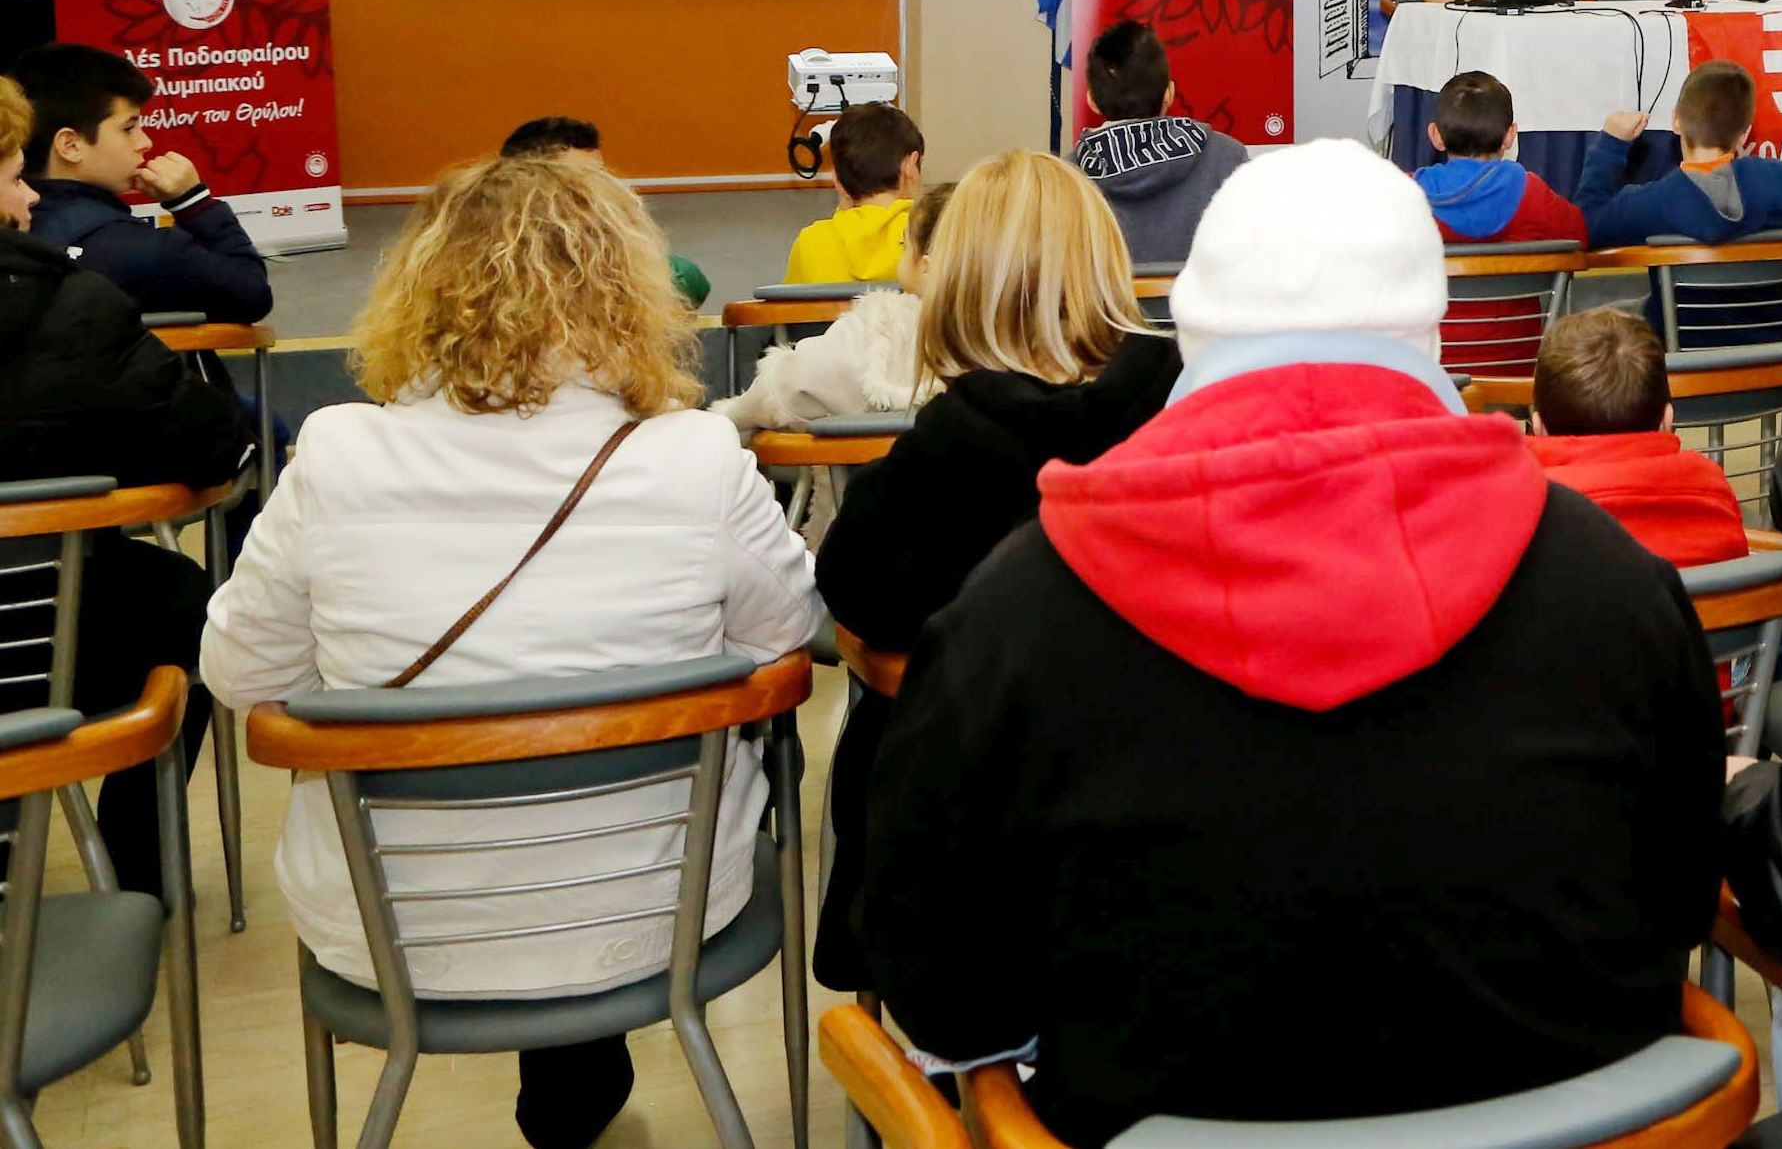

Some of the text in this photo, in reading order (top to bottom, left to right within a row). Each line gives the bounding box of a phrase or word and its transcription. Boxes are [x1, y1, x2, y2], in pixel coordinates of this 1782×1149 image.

[168, 42, 310, 67] Ποδοσφαίρου
[154, 71, 265, 99] λυμπιακού
[202, 109, 231, 124] του
[235, 97, 305, 128] Θρύλου!
